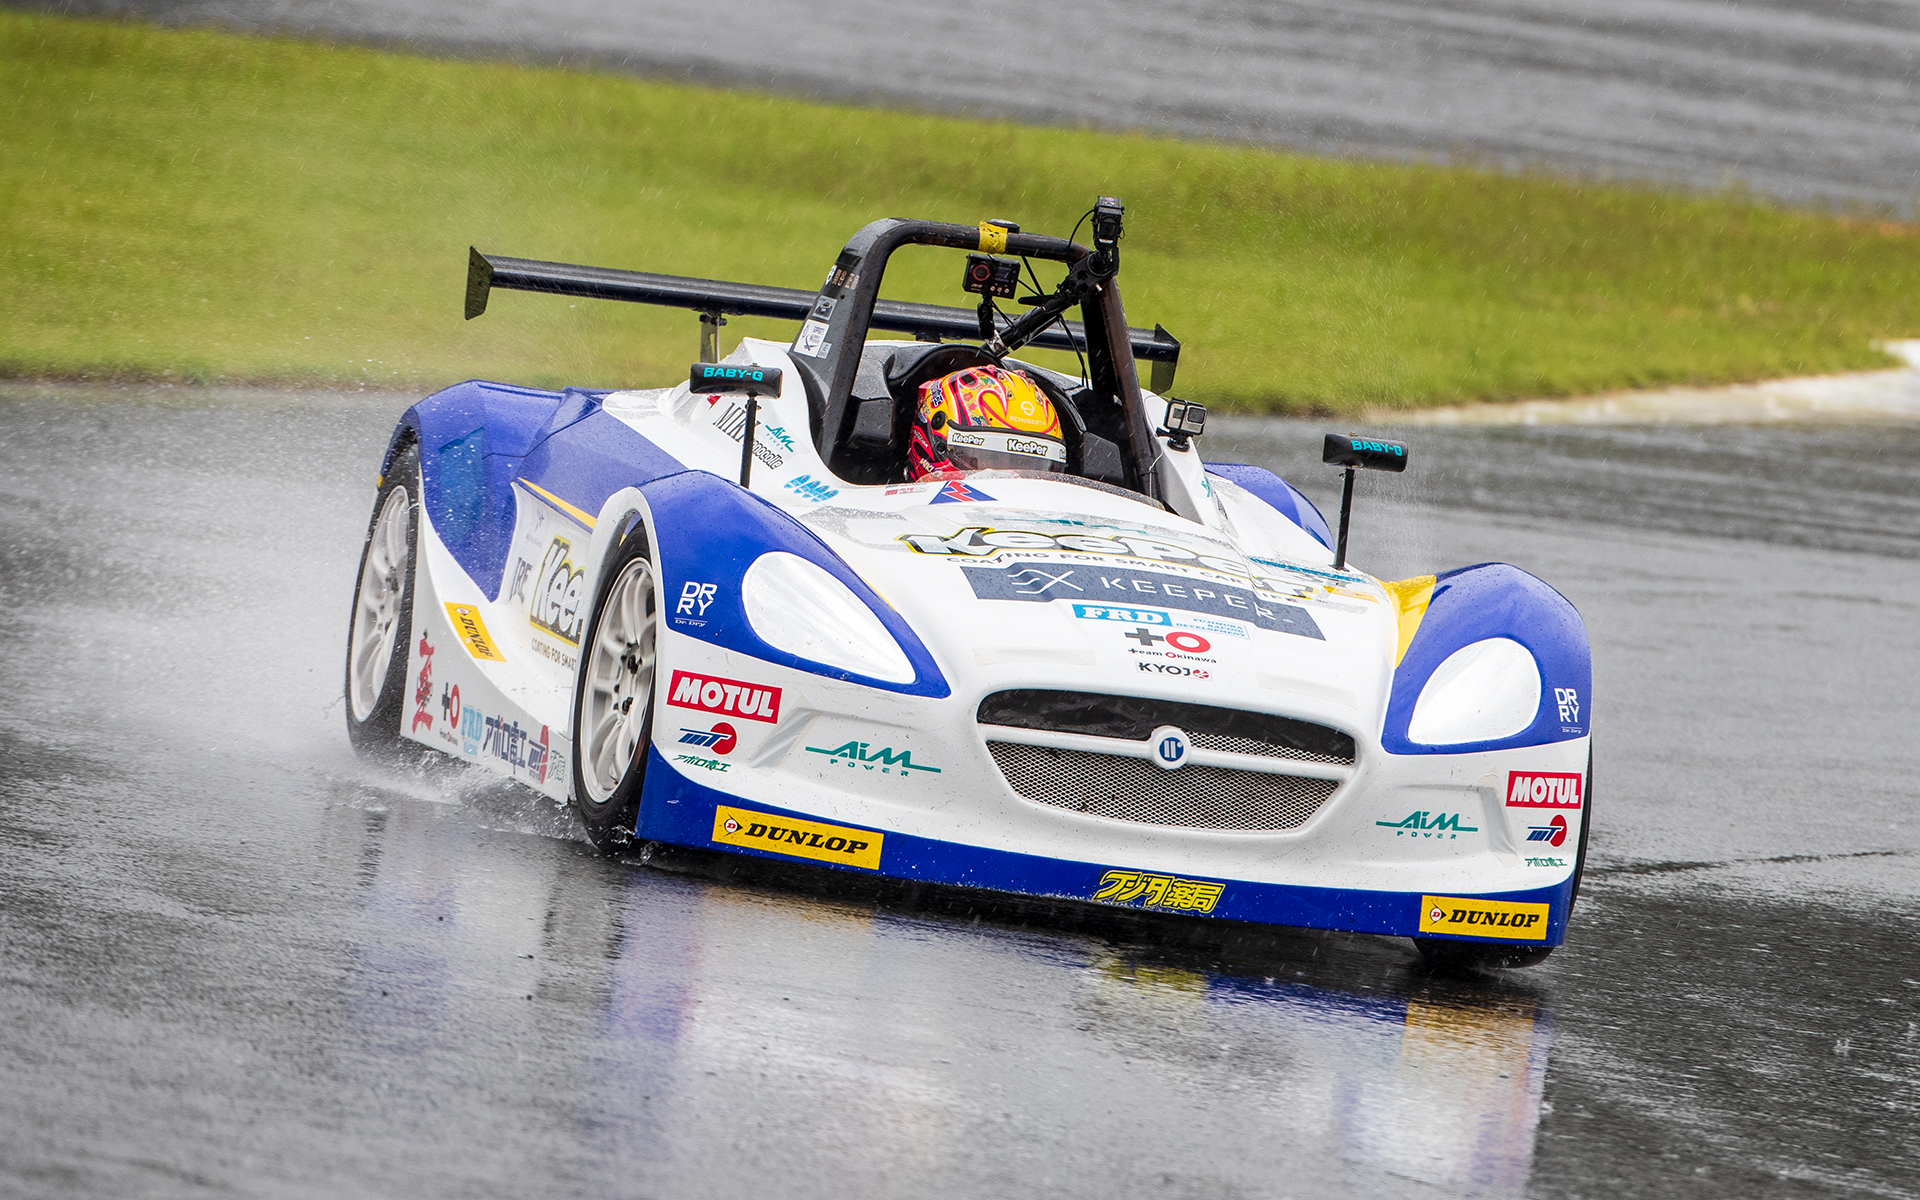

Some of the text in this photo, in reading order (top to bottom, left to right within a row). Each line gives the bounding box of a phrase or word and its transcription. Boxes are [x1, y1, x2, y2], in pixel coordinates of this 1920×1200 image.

[703, 367, 764, 382] BABY-G
[1009, 415, 1046, 426] SCHUBERTH
[952, 433, 985, 446] KeePer
[1007, 439, 1048, 457] KeePer
[1351, 440, 1403, 457] BABY-G
[947, 551, 1049, 565] COATING
[1059, 553, 1105, 562] FOR
[1115, 558, 1191, 573] SMART
[1199, 571, 1244, 585] CAR
[1100, 576, 1277, 621] KEEPER
[1082, 606, 1164, 624] FRD
[459, 616, 494, 659] DUNLOP
[1175, 622, 1247, 638] DEVELOPMENT
[672, 676, 774, 718] MOTUL
[461, 706, 483, 741] FRD
[830, 758, 909, 777] POWER
[1509, 776, 1580, 805] MOTUL
[745, 823, 869, 854] DUNLOP
[1396, 831, 1458, 840] POWER
[1448, 909, 1540, 929] DUNLOP
